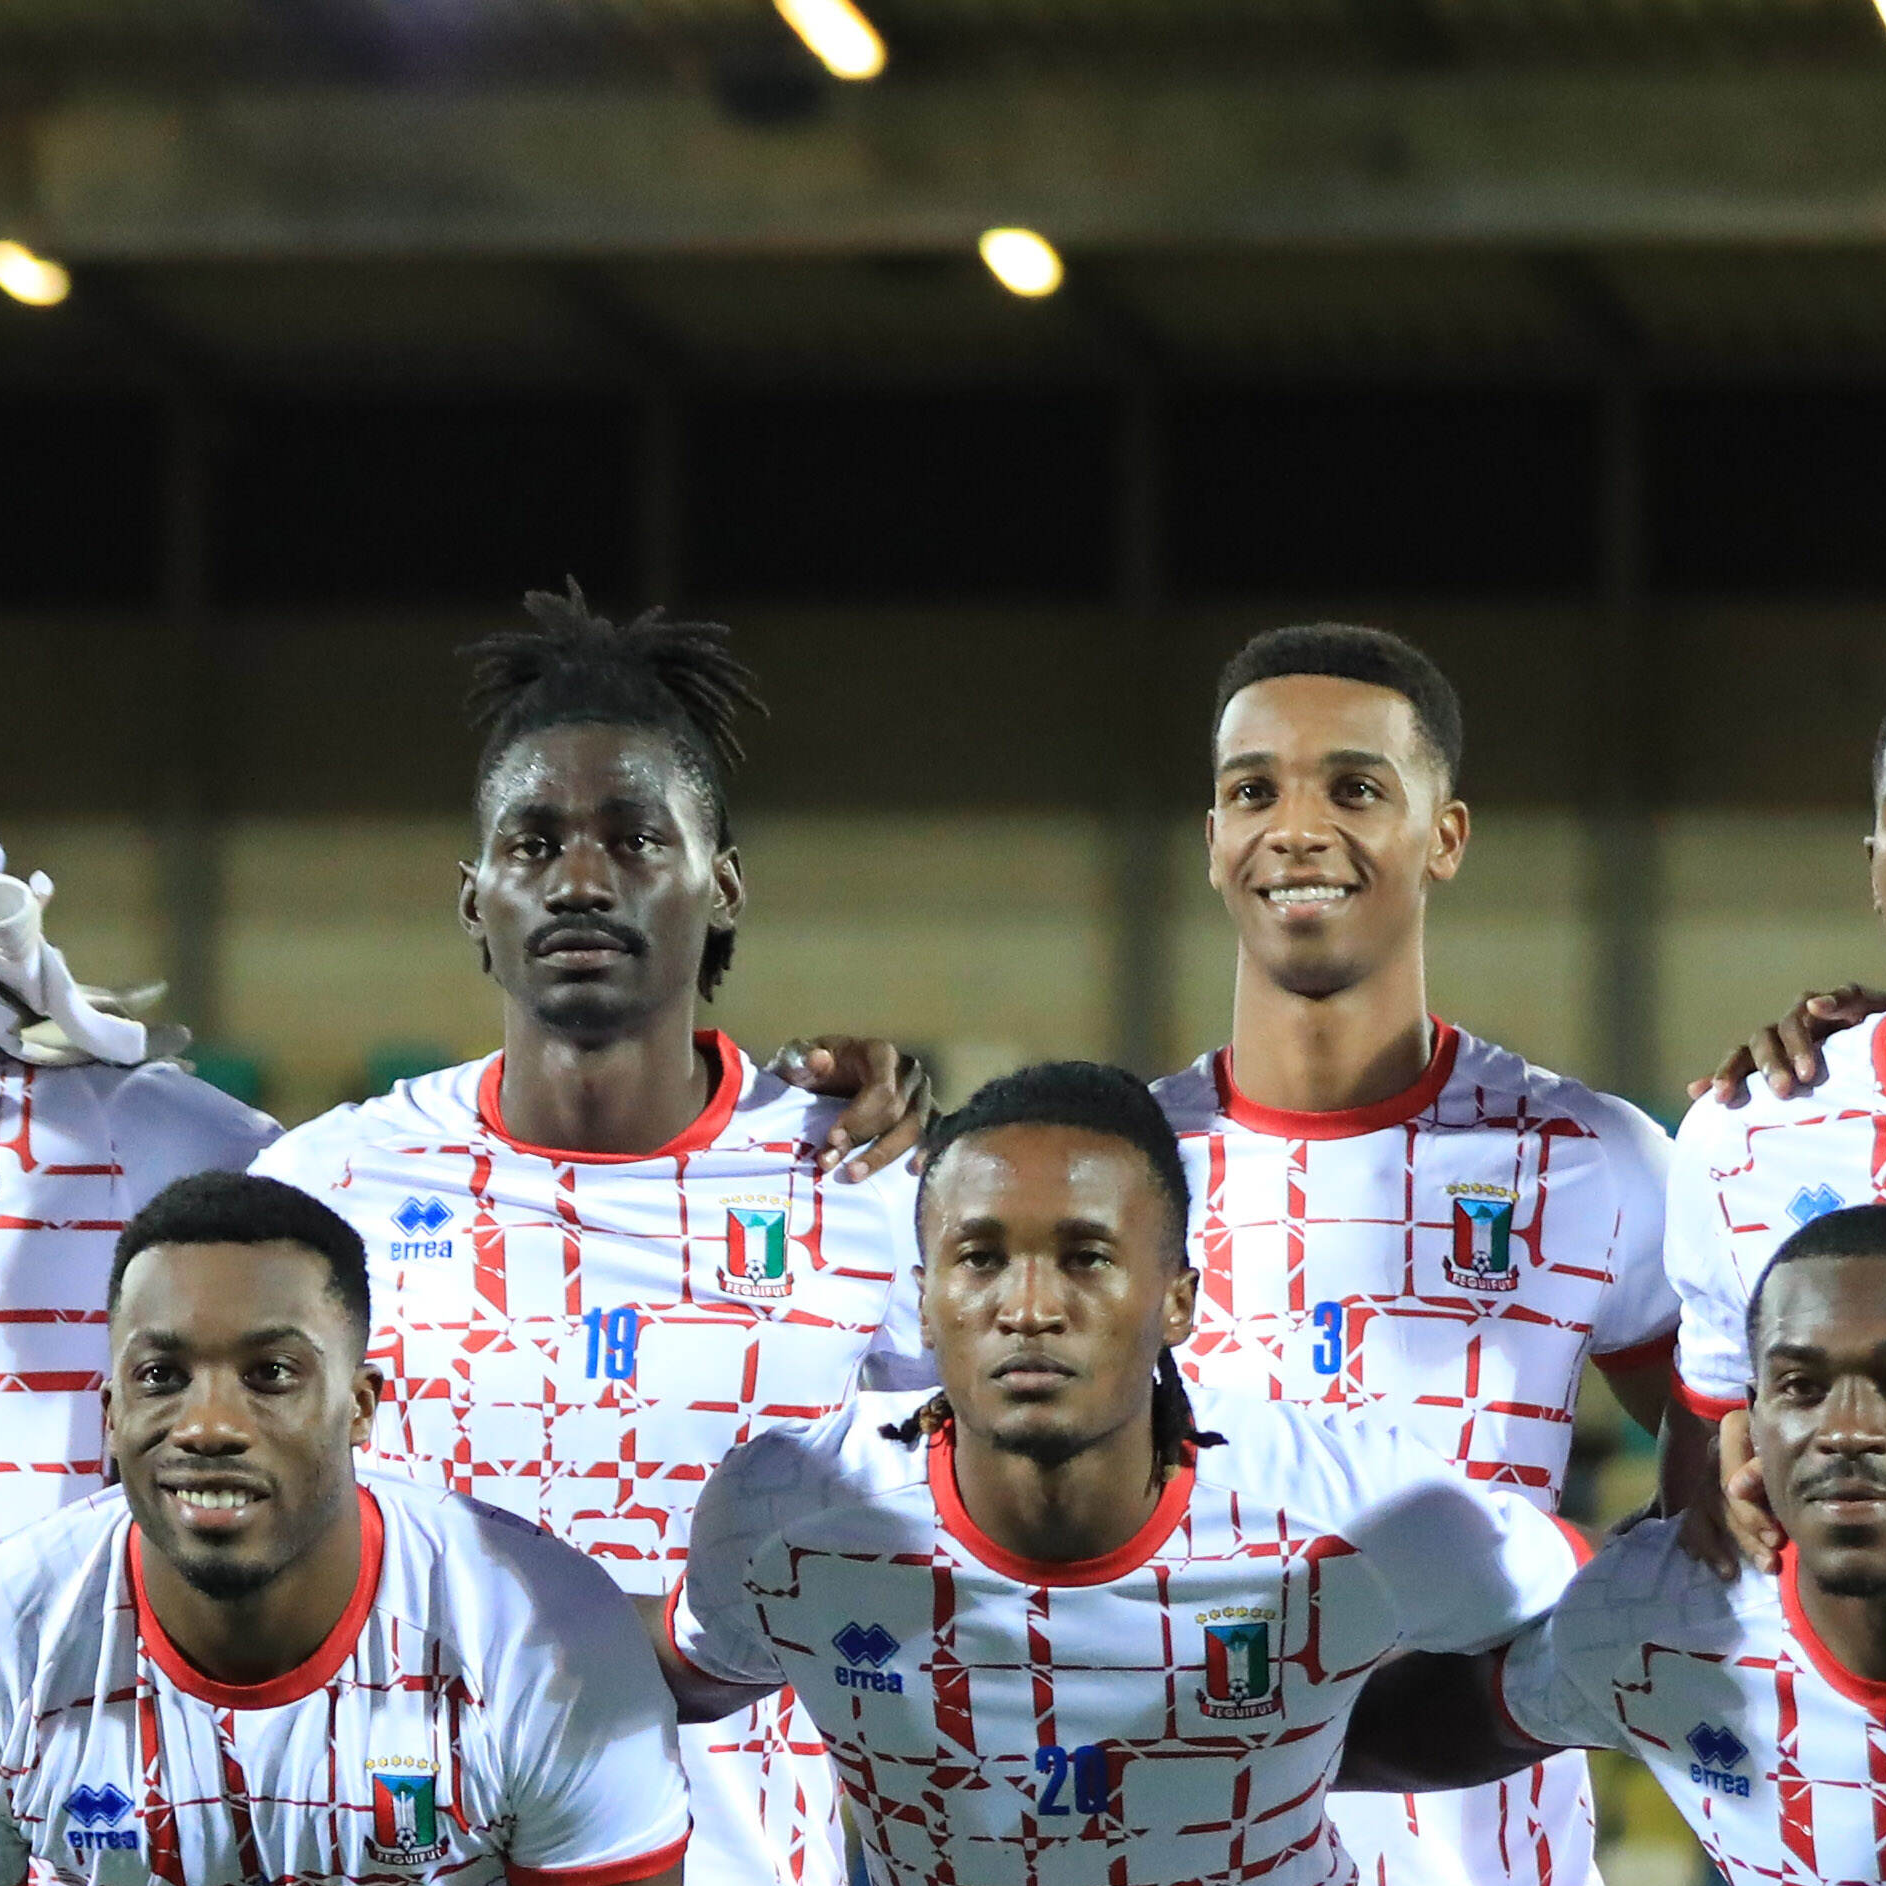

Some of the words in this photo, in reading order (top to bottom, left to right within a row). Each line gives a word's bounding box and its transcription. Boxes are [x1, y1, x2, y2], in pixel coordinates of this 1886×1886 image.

[390, 1239, 452, 1261] errea
[724, 1281, 788, 1298] FEGUIFUT
[1452, 1272, 1510, 1292] FEGUIFUT
[1313, 1301, 1343, 1375] 3
[834, 1665, 902, 1695] errea
[1208, 1702, 1273, 1719] FEGUIFUT
[1035, 1745, 1107, 1816] 20
[1689, 1763, 1750, 1799] errea
[67, 1830, 138, 1851] errea
[376, 1847, 442, 1865] FEGUIFUT
